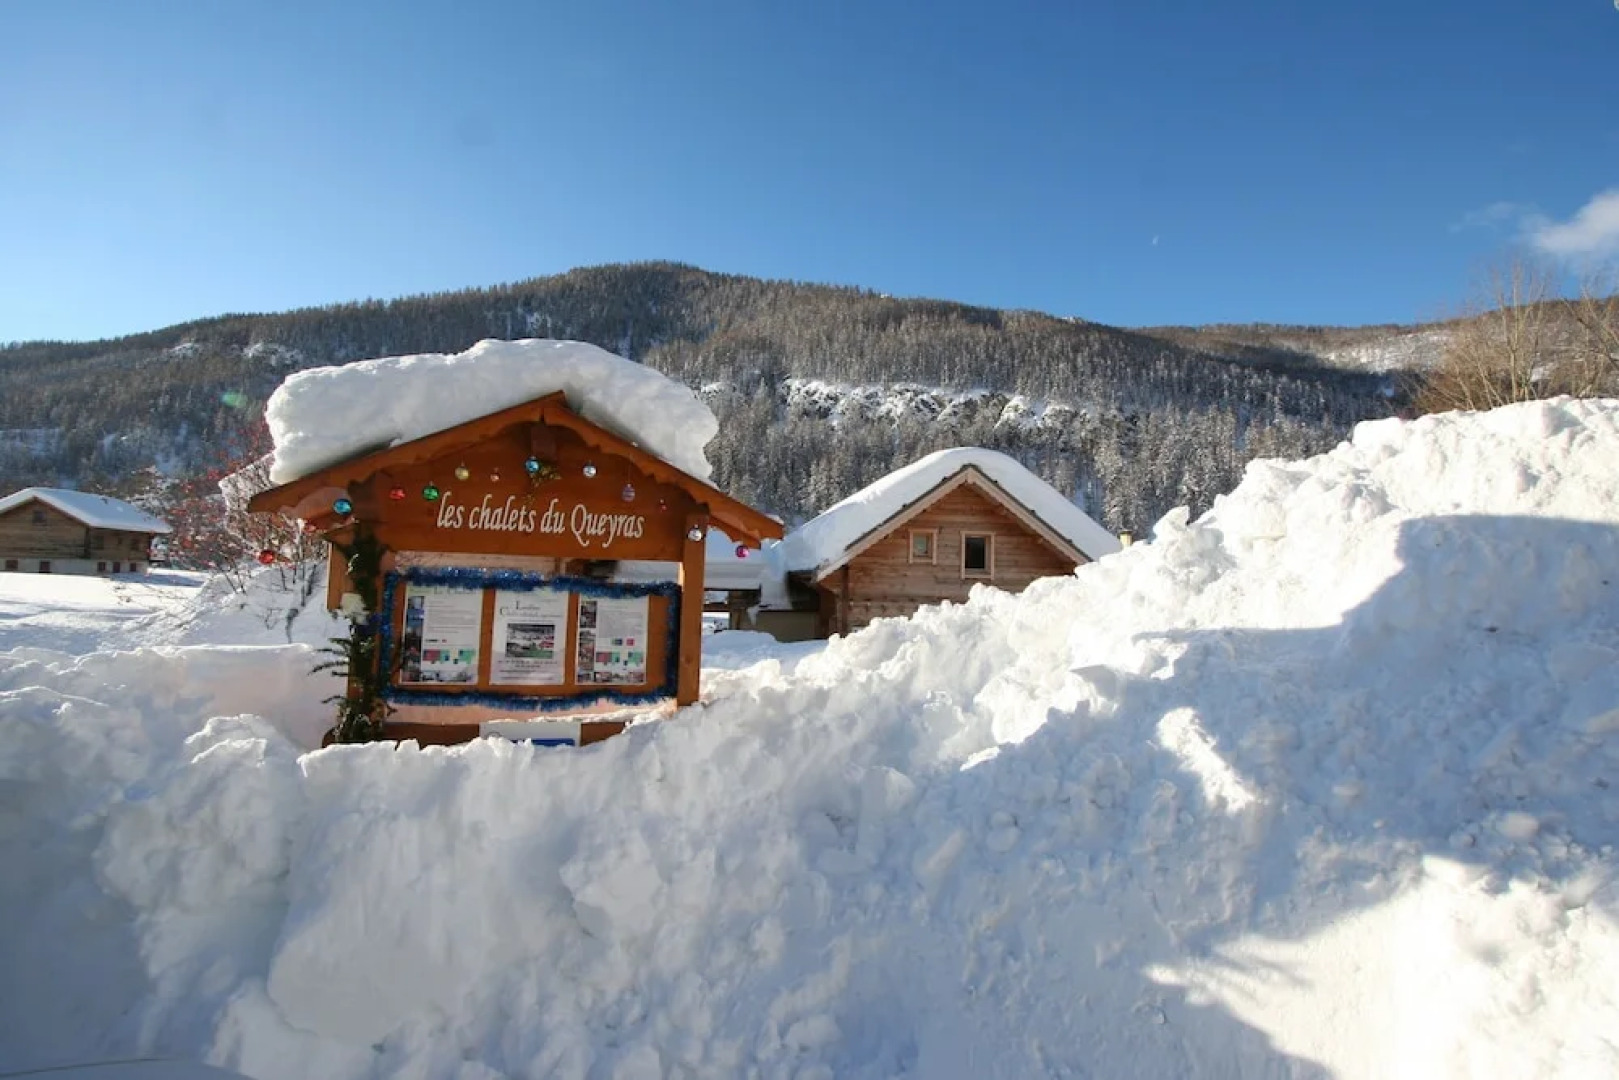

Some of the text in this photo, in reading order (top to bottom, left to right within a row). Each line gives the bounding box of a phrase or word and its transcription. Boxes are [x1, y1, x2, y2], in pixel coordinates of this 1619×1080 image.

[436, 491, 645, 548] les chalets du Queyras
